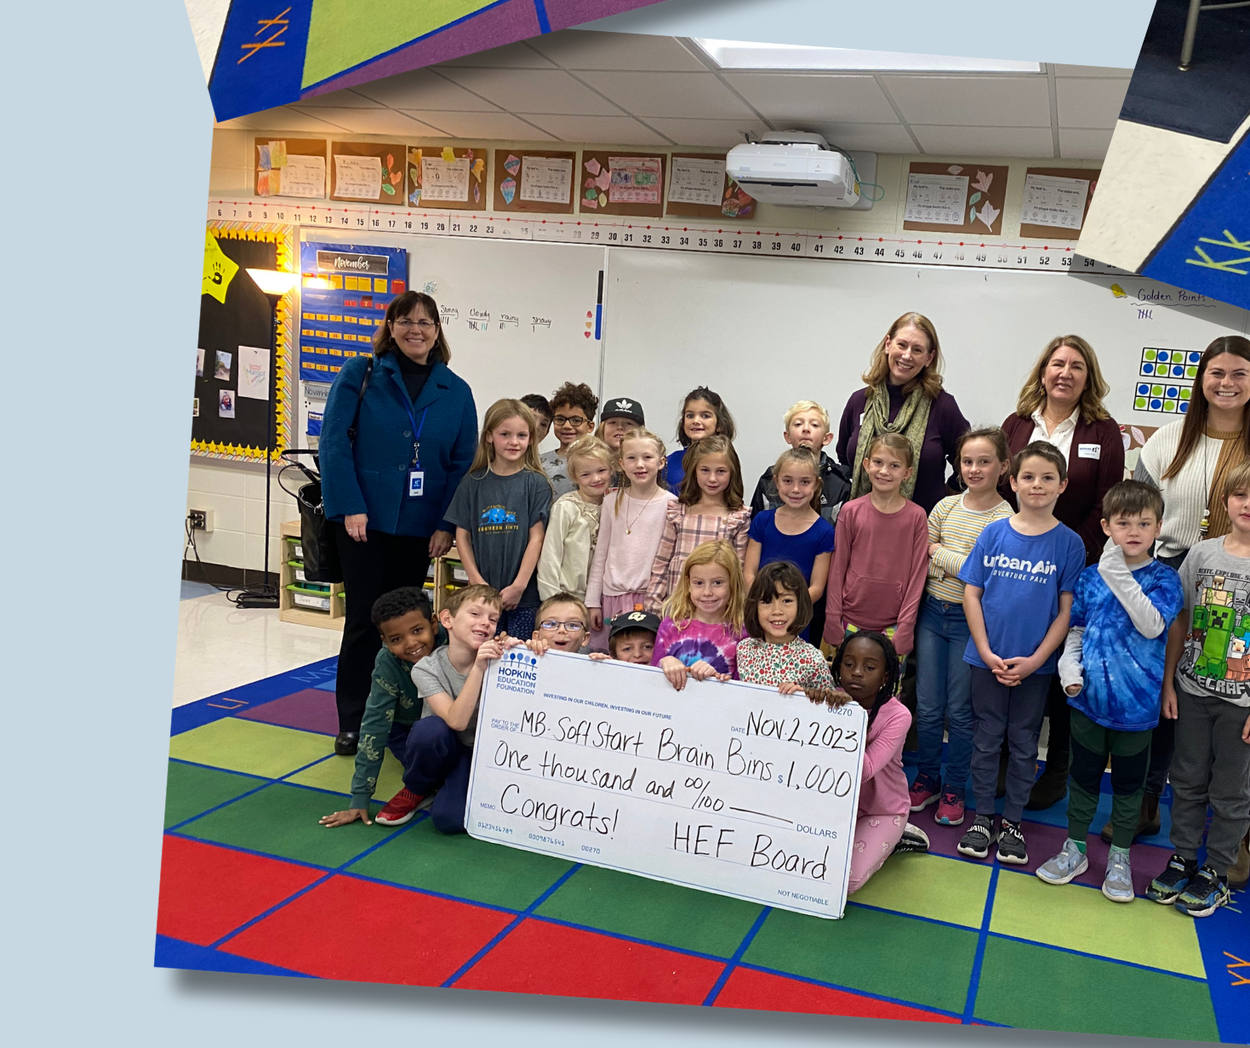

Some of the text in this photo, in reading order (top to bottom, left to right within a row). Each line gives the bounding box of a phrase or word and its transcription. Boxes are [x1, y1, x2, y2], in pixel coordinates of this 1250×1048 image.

[372, 219, 801, 251] 16 20 31 36 40
[334, 255, 371, 270] November
[1137, 288, 1206, 302] Golden Points
[1029, 575, 1048, 584] PARK
[498, 667, 537, 681] HOPKINS
[496, 683, 535, 695] FOUNDATION
[497, 676, 536, 689] EDUCATION
[543, 693, 568, 702] INVESTING
[609, 704, 634, 713] INVESTING
[652, 712, 672, 720] FUTURE
[730, 726, 745, 734] DATE
[592, 720, 644, 756] Start
[657, 727, 714, 769] Brain
[726, 737, 774, 781] Bins
[494, 740, 531, 772] One
[539, 751, 637, 792] thousand
[645, 780, 675, 799] and
[480, 802, 496, 811] MEMO
[500, 783, 619, 840] Congrats!
[796, 824, 838, 839] DOLLARS
[673, 822, 829, 881] HEF Board
[777, 889, 829, 906] NOT NEGOTIABLE
